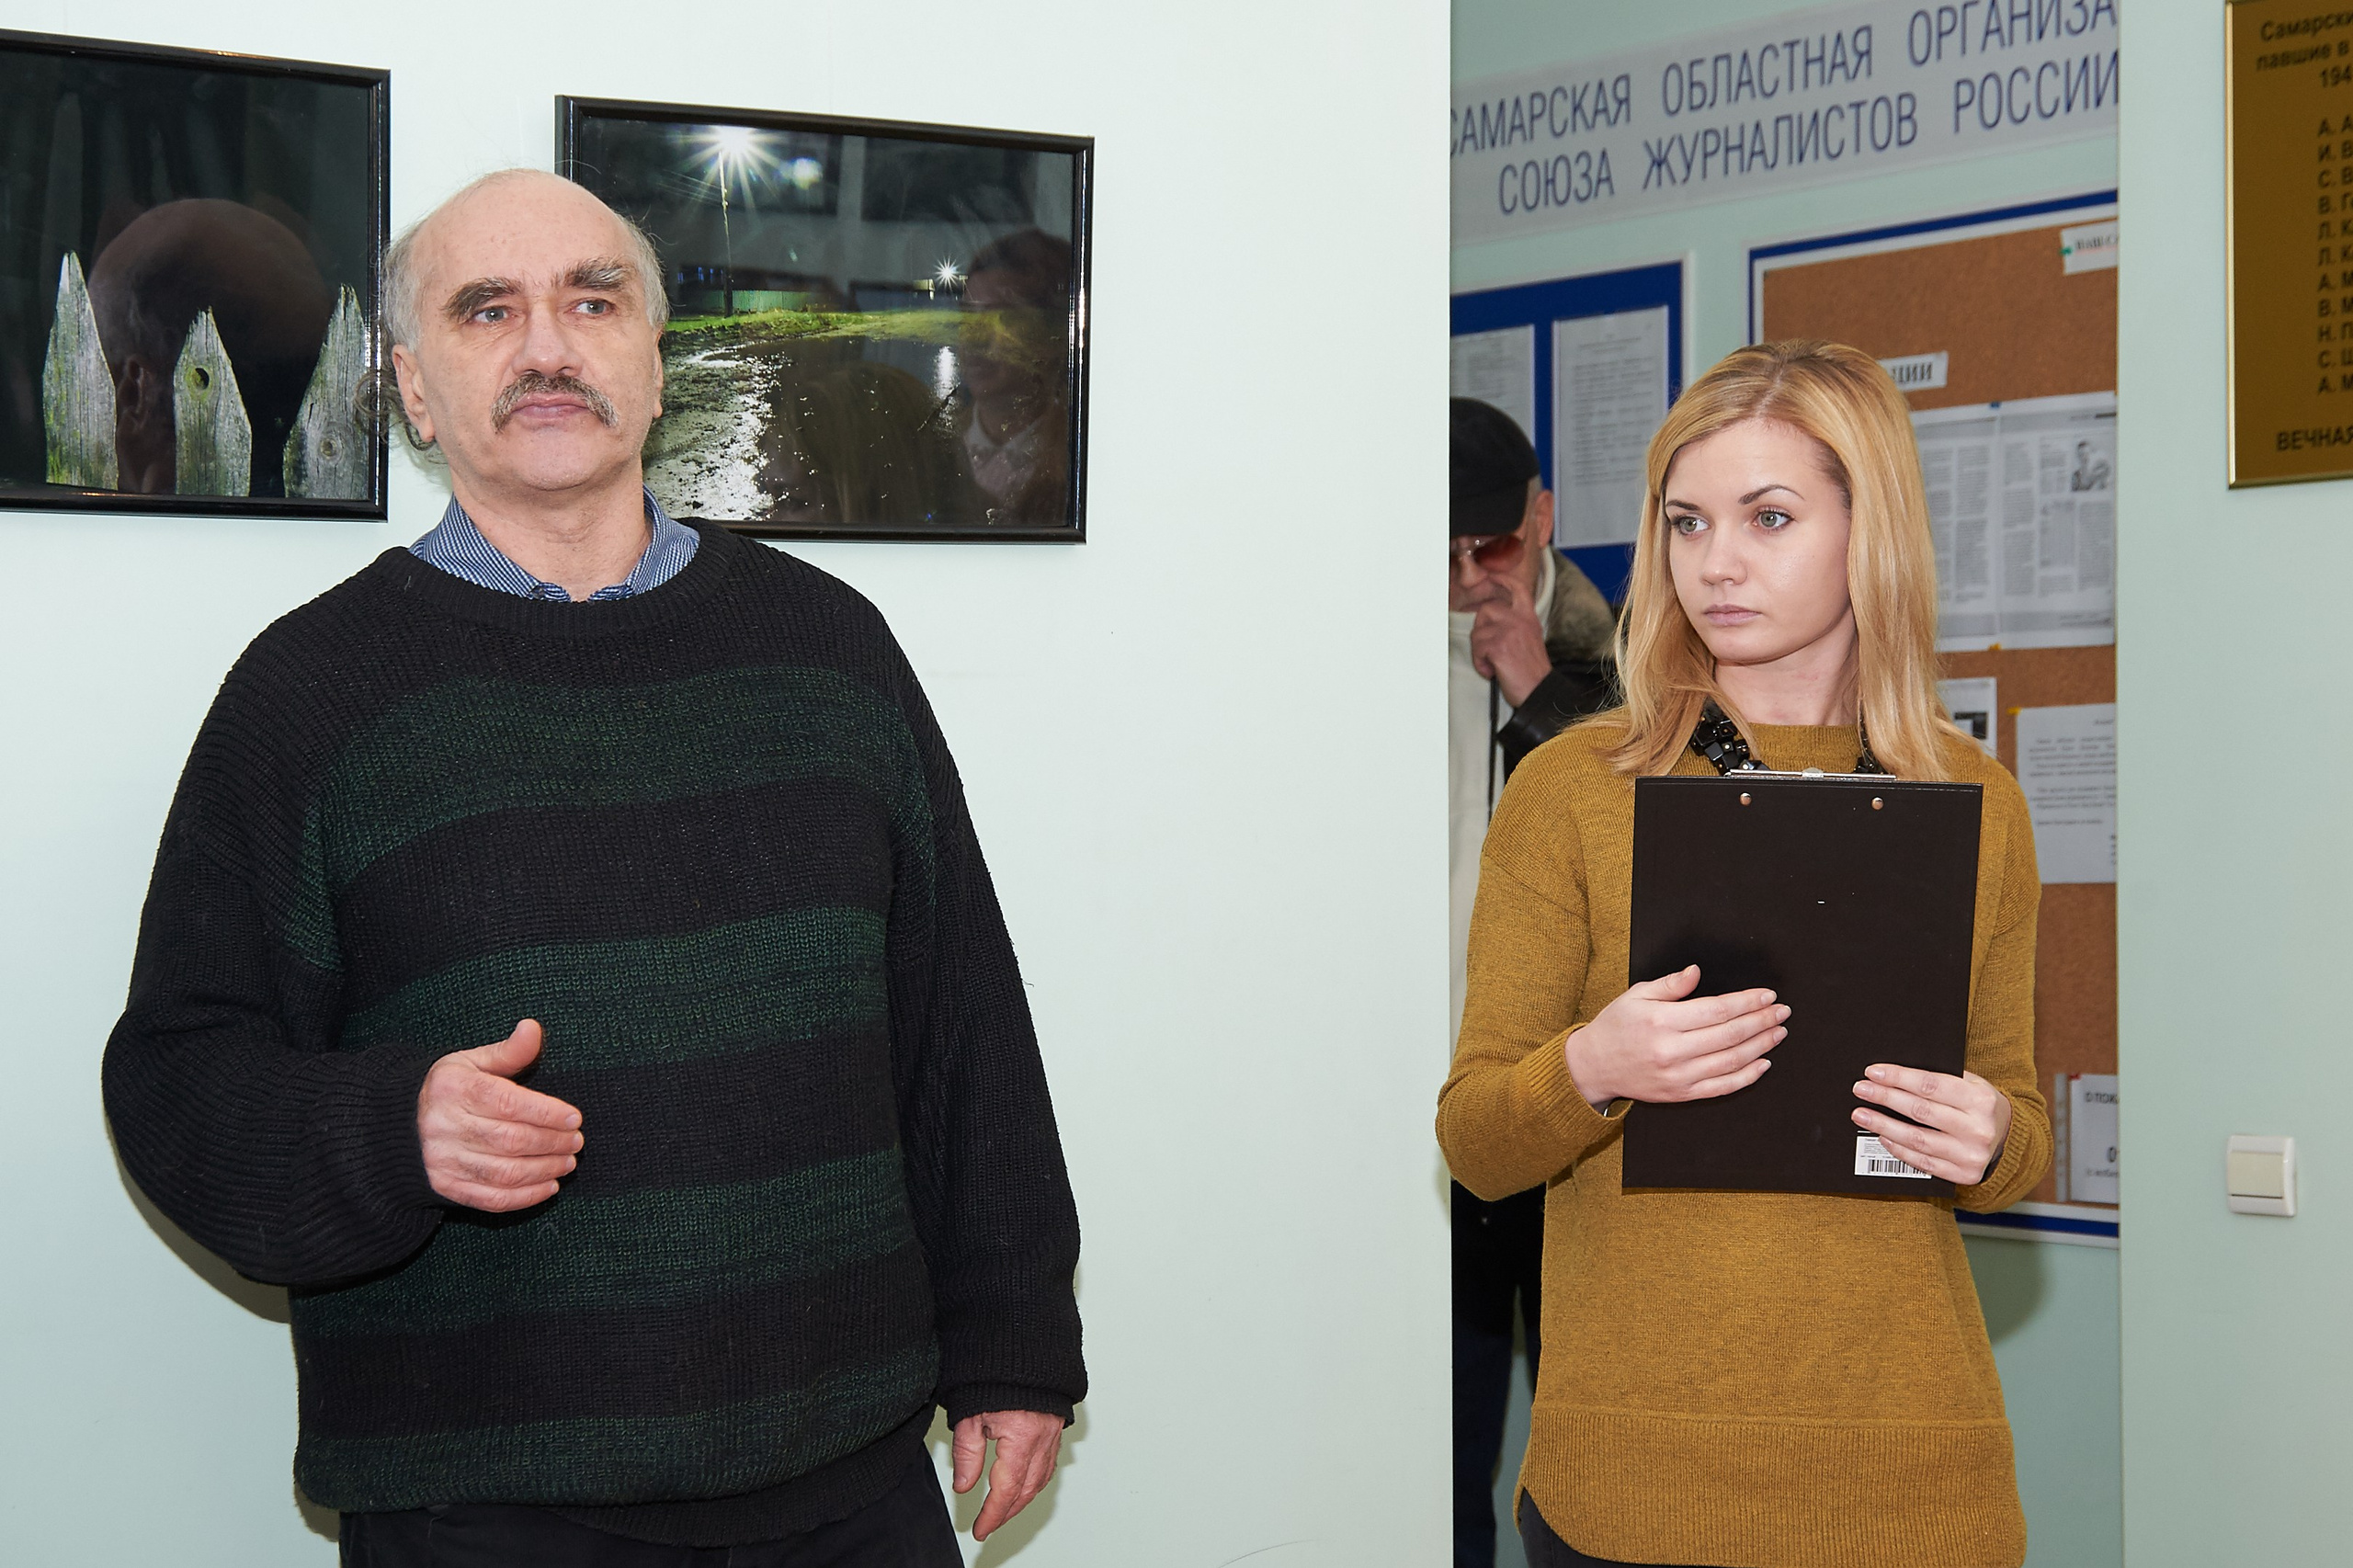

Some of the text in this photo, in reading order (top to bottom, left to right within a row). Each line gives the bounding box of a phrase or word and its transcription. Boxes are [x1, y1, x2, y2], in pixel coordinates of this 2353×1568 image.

[1498, 48, 2120, 215] СОЮЗА ЖУРНАЛИСТОВ РОССИИ
[1662, 24, 1873, 117] ОБЛАСТНАЯ
